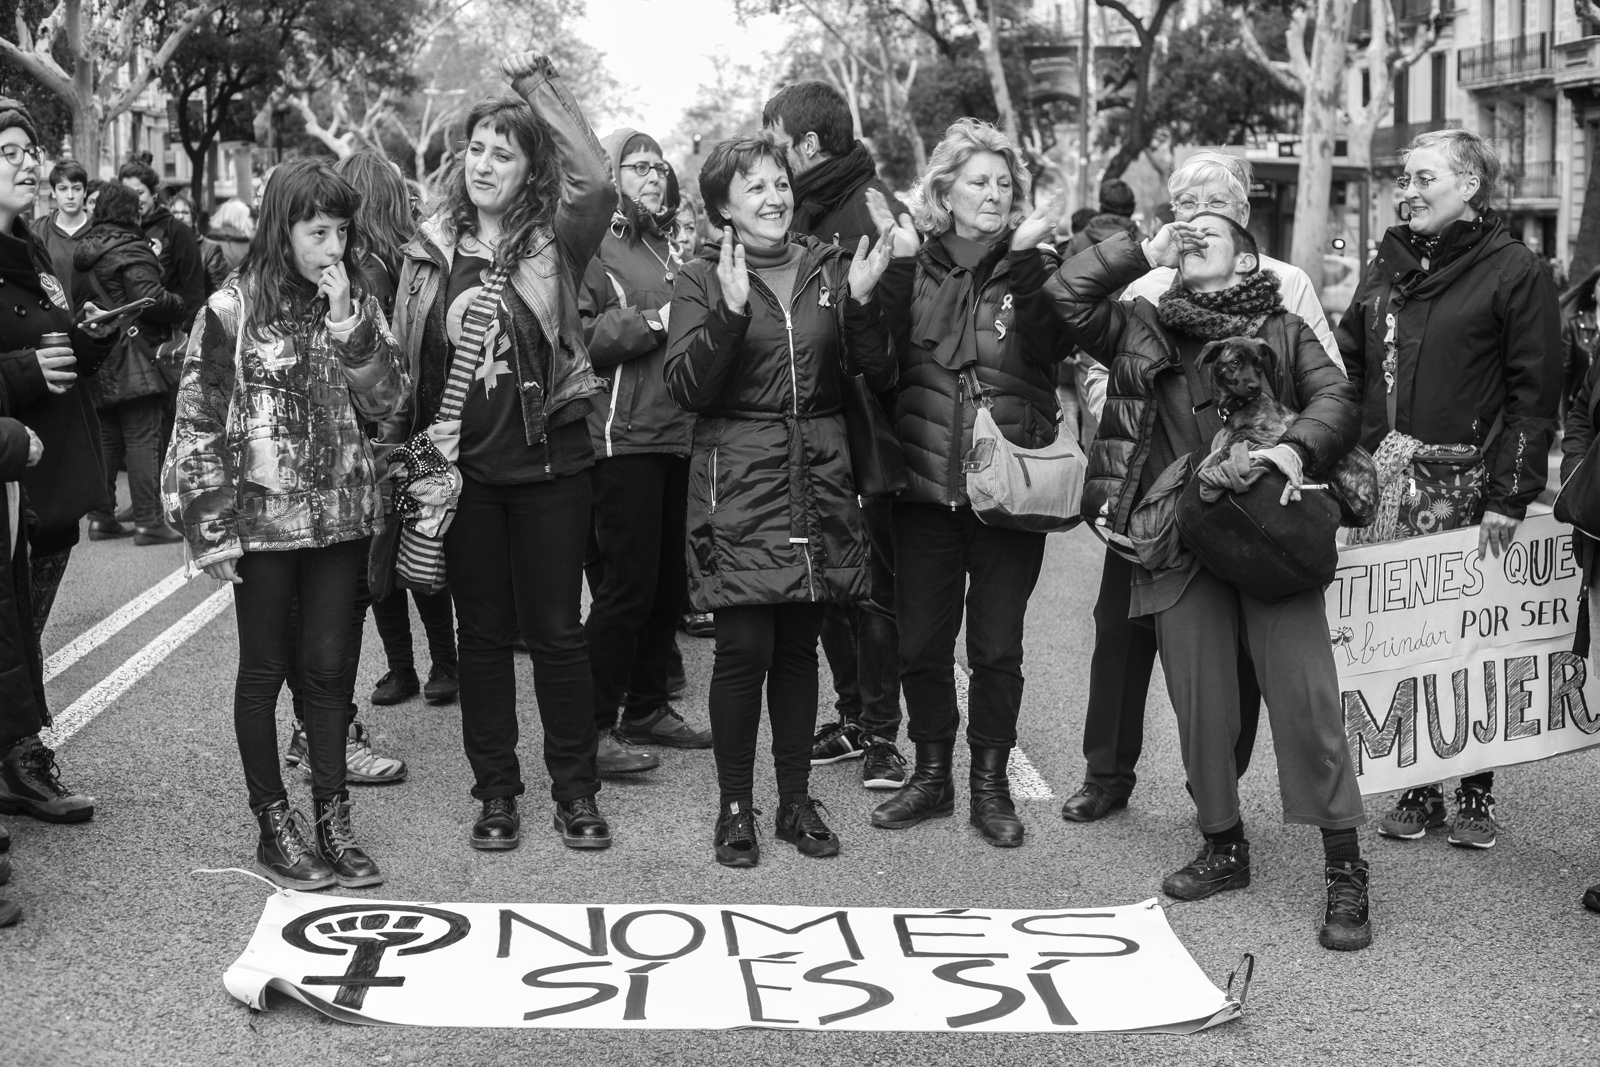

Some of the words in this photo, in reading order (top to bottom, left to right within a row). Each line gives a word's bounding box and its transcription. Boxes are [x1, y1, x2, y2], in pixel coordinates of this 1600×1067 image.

[1334, 548, 1484, 619] TIENES
[1503, 534, 1576, 586] QUE
[1360, 621, 1452, 664] brindar
[1460, 605, 1509, 639] POR
[1520, 598, 1570, 627] SER
[1341, 651, 1600, 777] MUJER
[496, 907, 1140, 961] NOMÉS
[521, 961, 671, 1021] SÍ
[739, 951, 895, 1026] ÉS
[931, 958, 1079, 1028] SÍ
